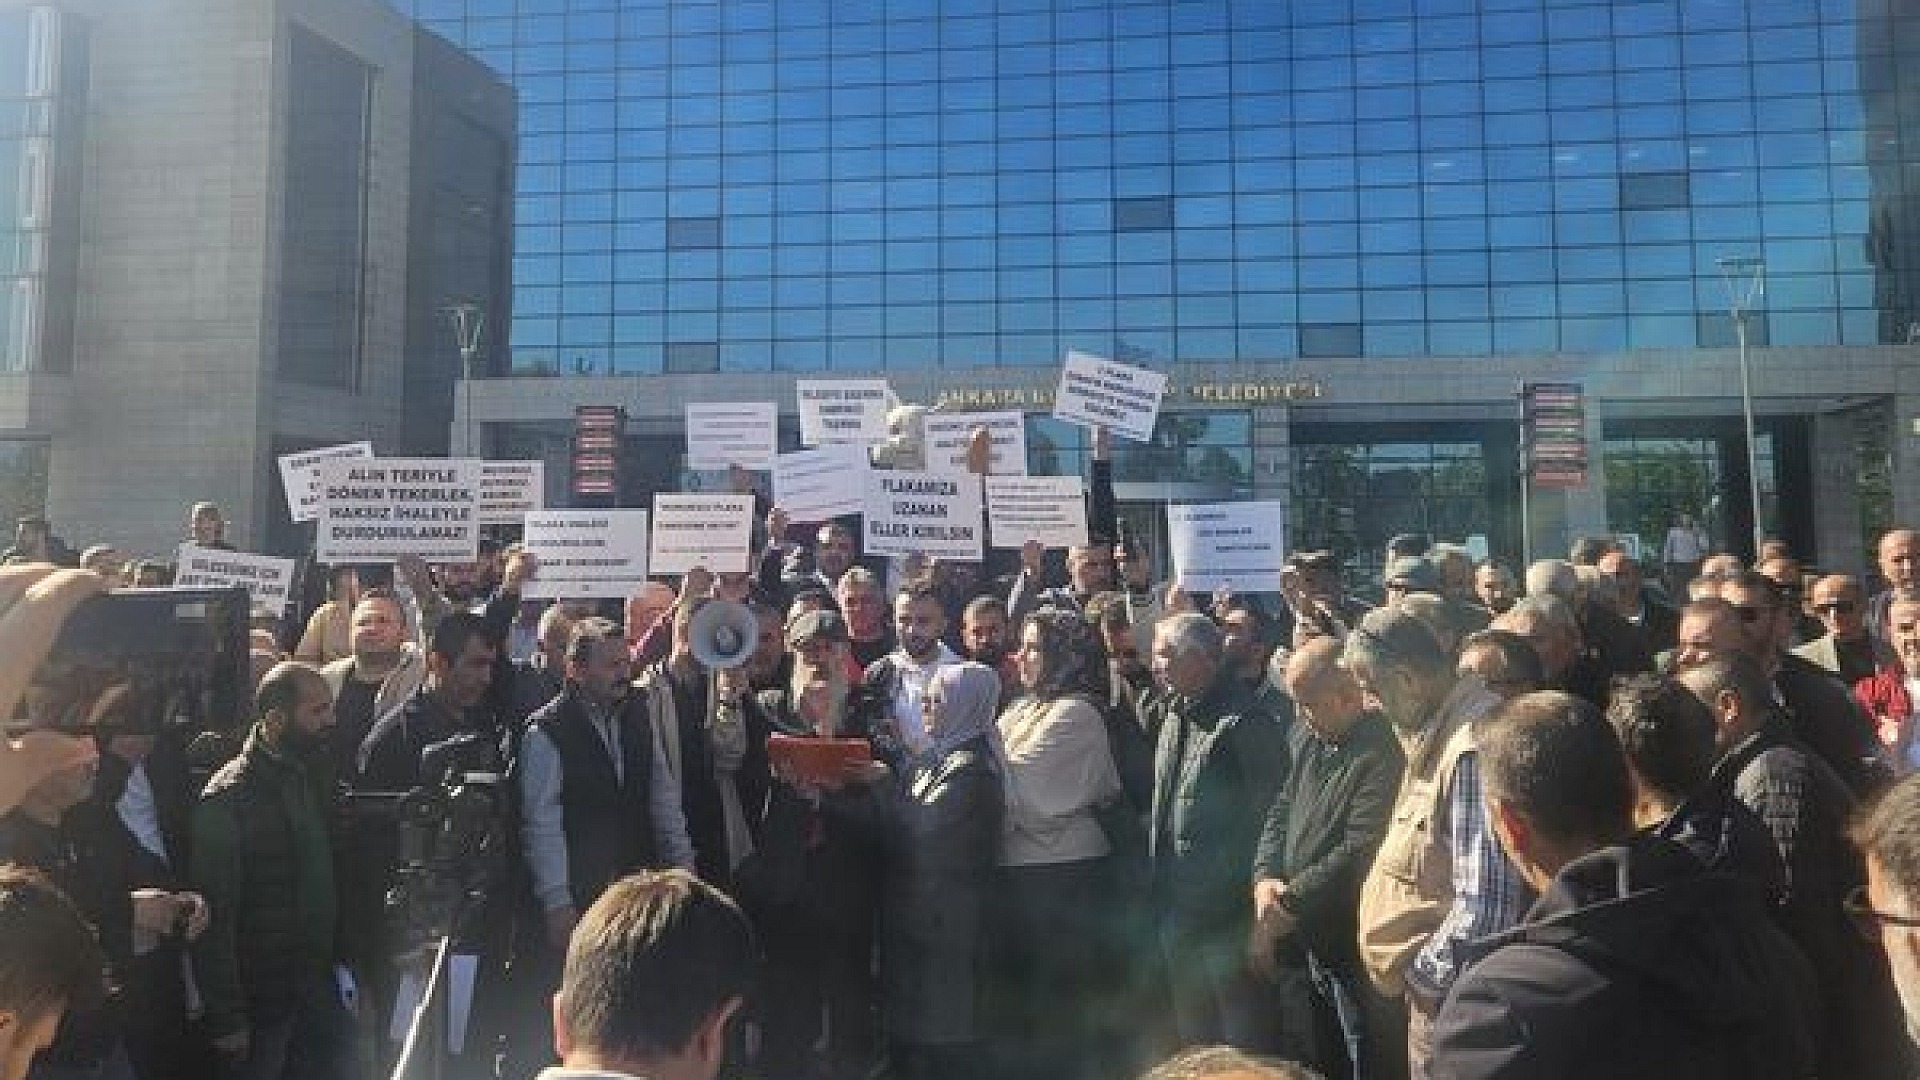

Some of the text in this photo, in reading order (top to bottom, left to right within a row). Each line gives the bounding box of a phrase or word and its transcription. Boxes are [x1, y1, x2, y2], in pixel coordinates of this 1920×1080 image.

[391, 468, 457, 483] TERİYLE
[326, 486, 384, 500] DÖNEN
[881, 478, 958, 496] PLAKAMIZA
[329, 507, 391, 520] HAKSIZ
[394, 504, 470, 521] İHALEYLE
[892, 501, 948, 518] UZANAN
